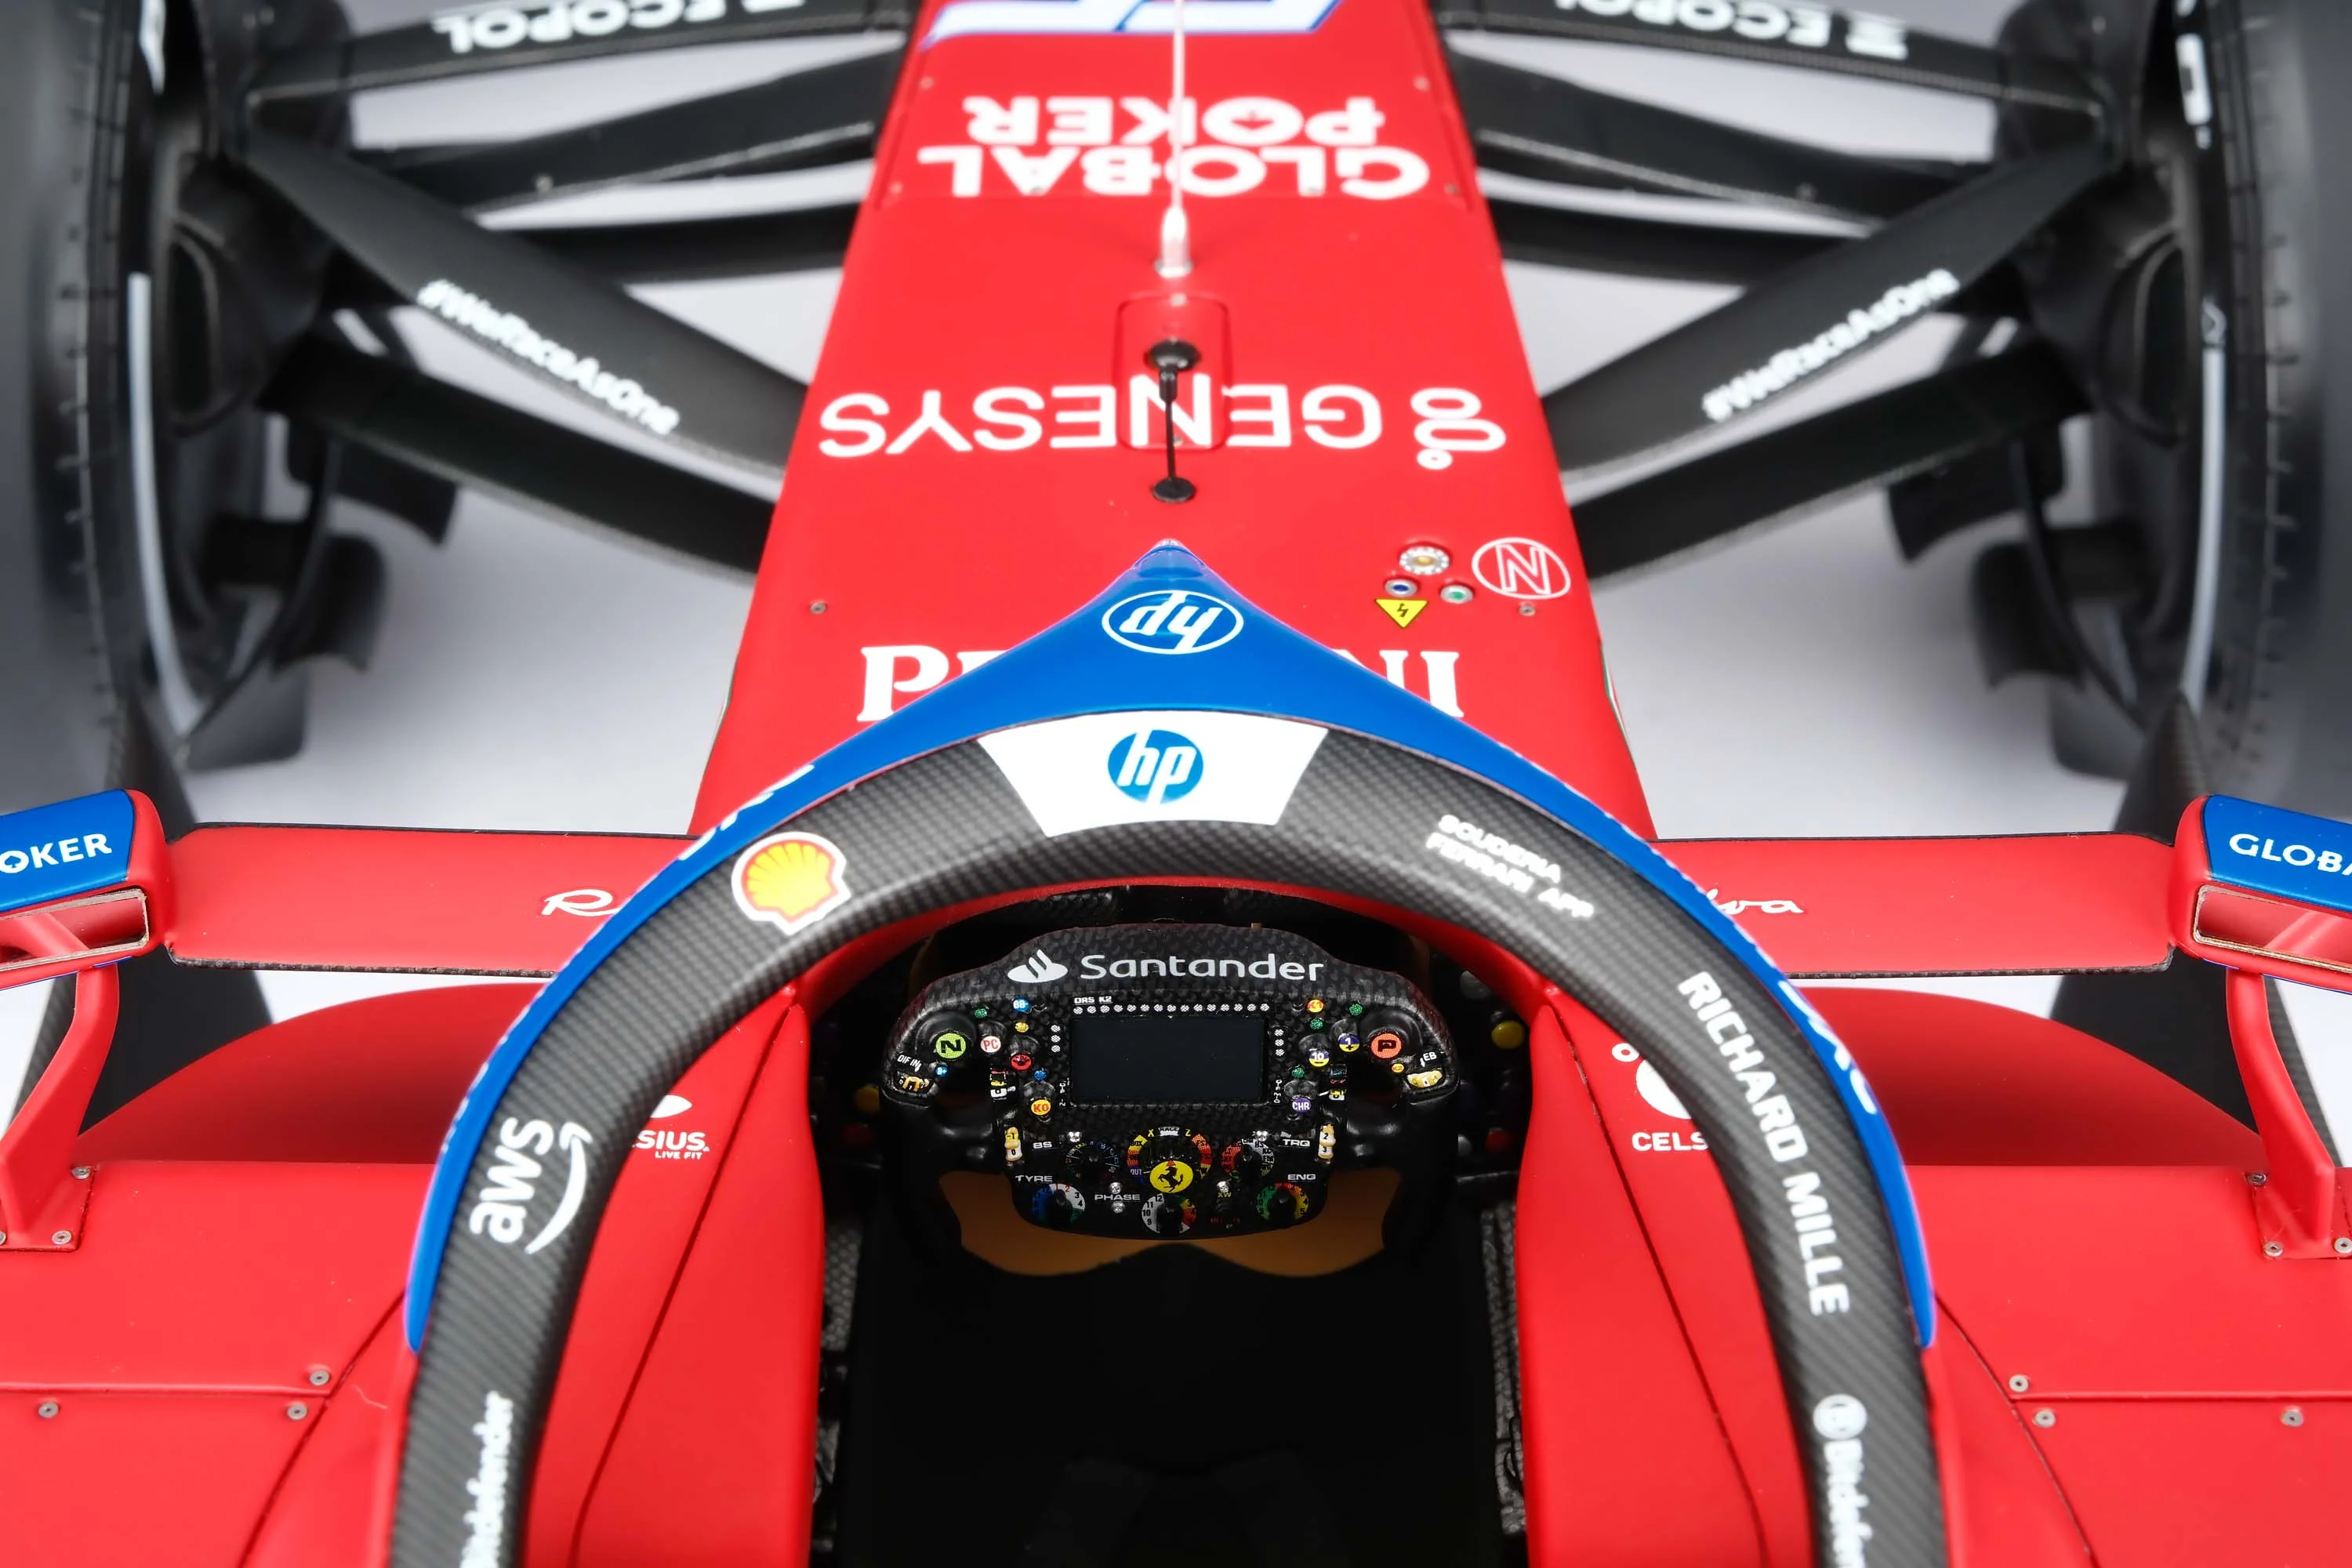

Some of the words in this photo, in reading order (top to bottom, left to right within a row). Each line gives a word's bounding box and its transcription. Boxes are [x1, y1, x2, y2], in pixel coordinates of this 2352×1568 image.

[1555, 0, 1831, 47] ECOP
[962, 96, 1386, 146] POKER
[917, 146, 1430, 200] GLOBAL
[819, 373, 1383, 458] GENESYS
[1115, 730, 1200, 805] hp
[0, 833, 112, 873] OKER
[2229, 833, 2352, 876] GLOB
[1080, 953, 1324, 981] Santander
[940, 1039, 962, 1054] N
[983, 1039, 999, 1050] PC
[1377, 1039, 1397, 1052] P
[1292, 1101, 1311, 1111] CHR
[636, 1130, 706, 1151] SIUS
[1033, 1141, 1053, 1149] BS
[1282, 1138, 1311, 1147] TRQ
[1631, 1131, 1709, 1152] CELS
[1677, 971, 1809, 1163] RICHARD
[1781, 1171, 1850, 1316] MILLE
[655, 1150, 681, 1160] LIVE
[684, 1152, 703, 1160] FIT
[470, 1116, 555, 1244] aws
